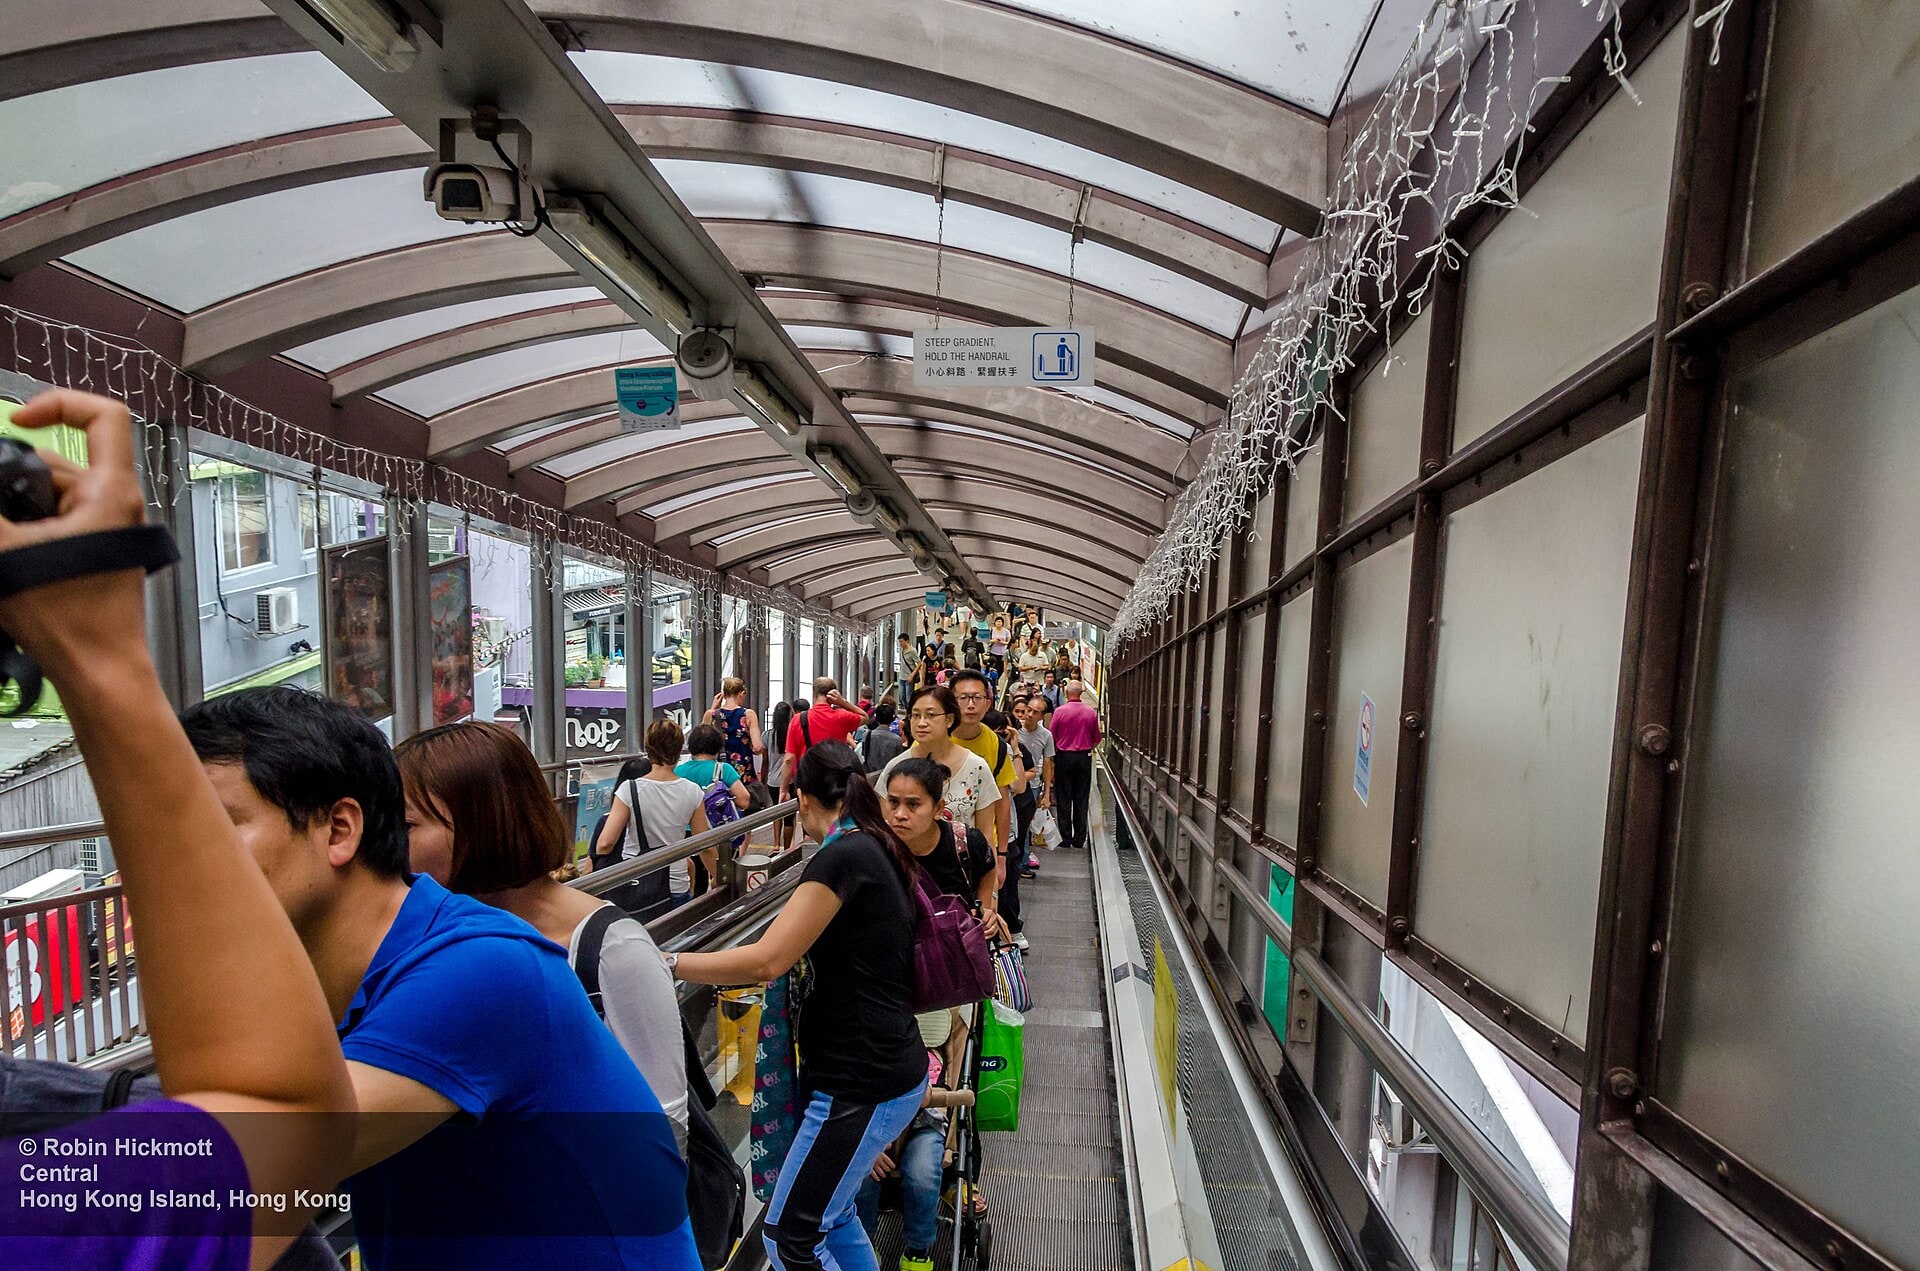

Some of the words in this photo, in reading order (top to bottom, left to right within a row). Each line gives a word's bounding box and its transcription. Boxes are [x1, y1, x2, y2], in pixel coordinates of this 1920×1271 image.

[925, 337, 951, 348] STEEP
[953, 337, 996, 348] GRADIENT,
[925, 351, 947, 361] HOLD
[950, 351, 966, 361] THE
[968, 351, 1010, 361] HANDRAIL
